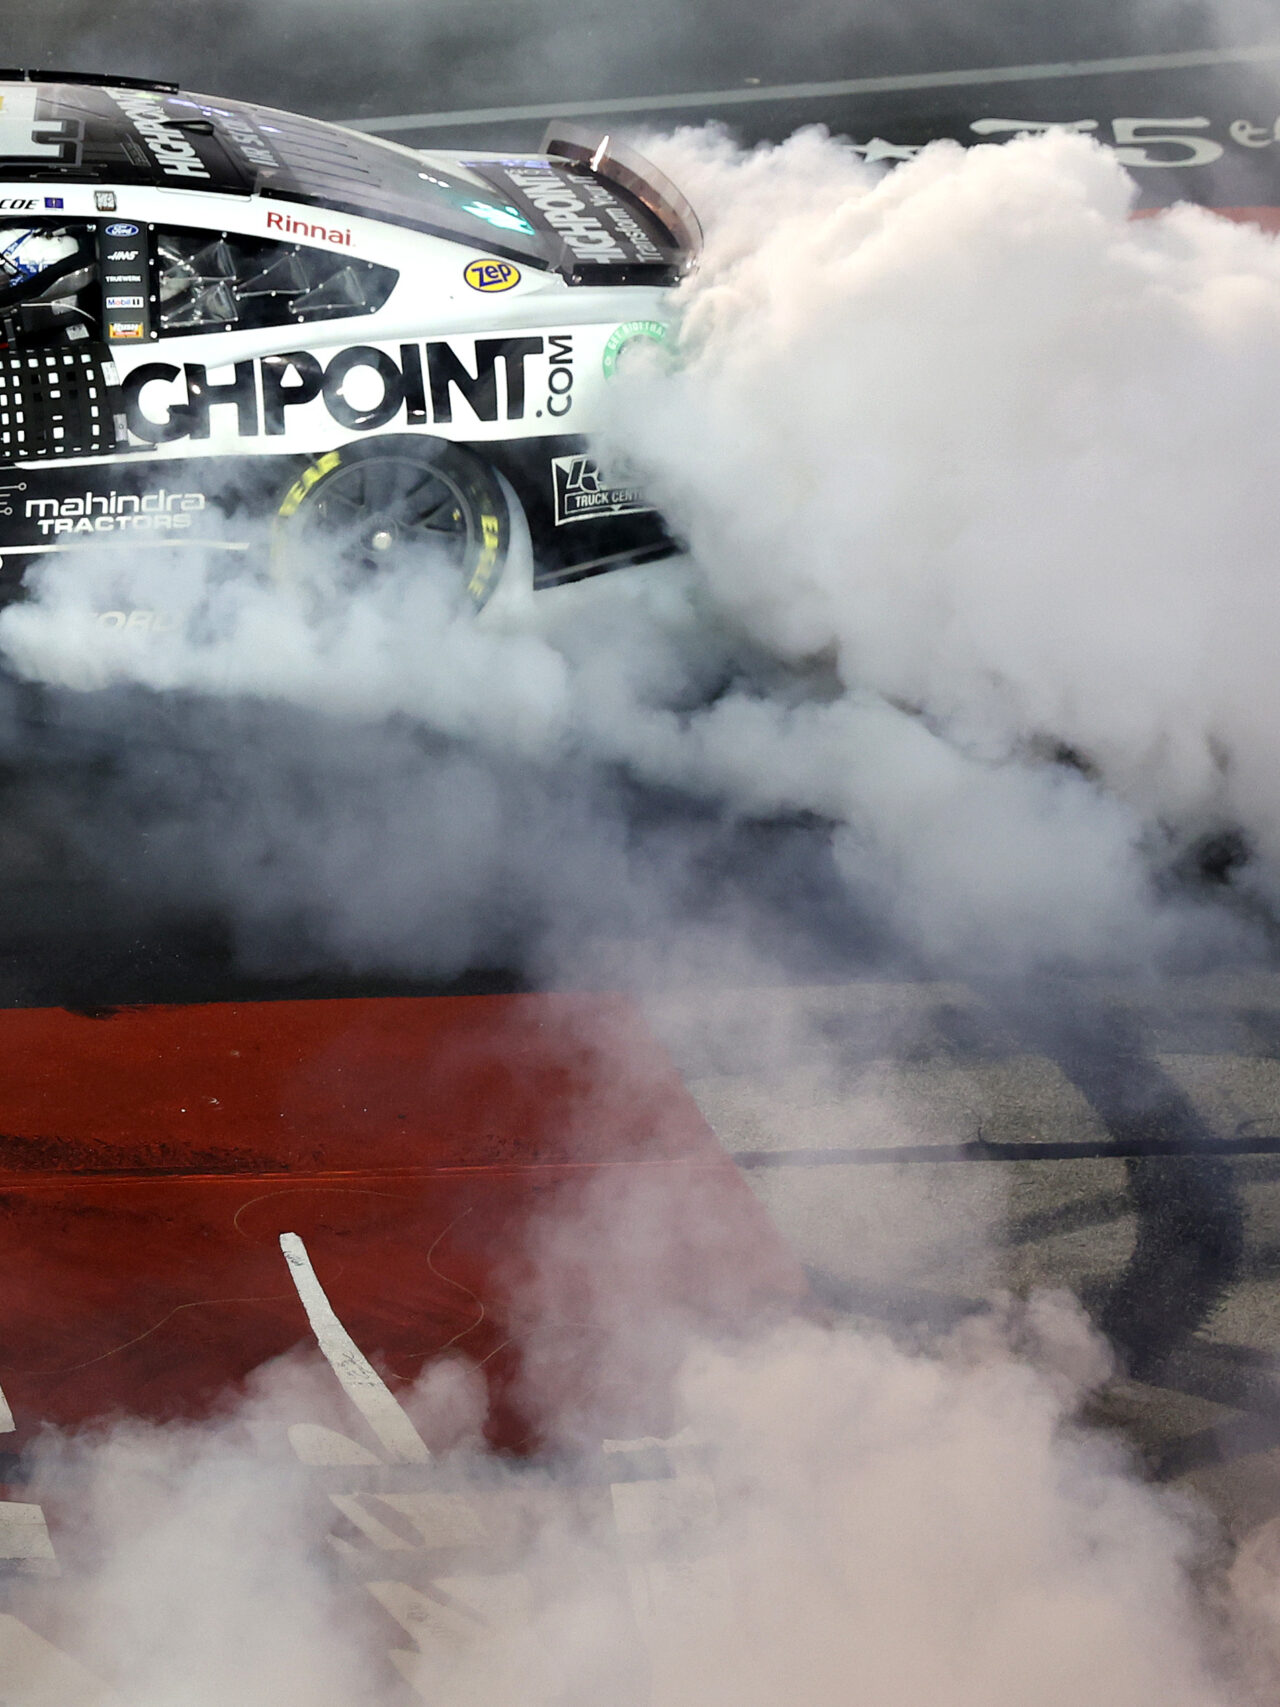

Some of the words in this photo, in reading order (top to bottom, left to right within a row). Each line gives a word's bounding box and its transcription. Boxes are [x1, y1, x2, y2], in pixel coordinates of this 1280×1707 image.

[107, 224, 137, 236] Ford
[266, 211, 353, 247] Rinnai
[120, 337, 545, 443] GHPOINT
[536, 334, 574, 418] .COM
[25, 489, 206, 518] mahindra
[575, 493, 609, 508] TRUCK
[37, 513, 193, 535] TRACTORS
